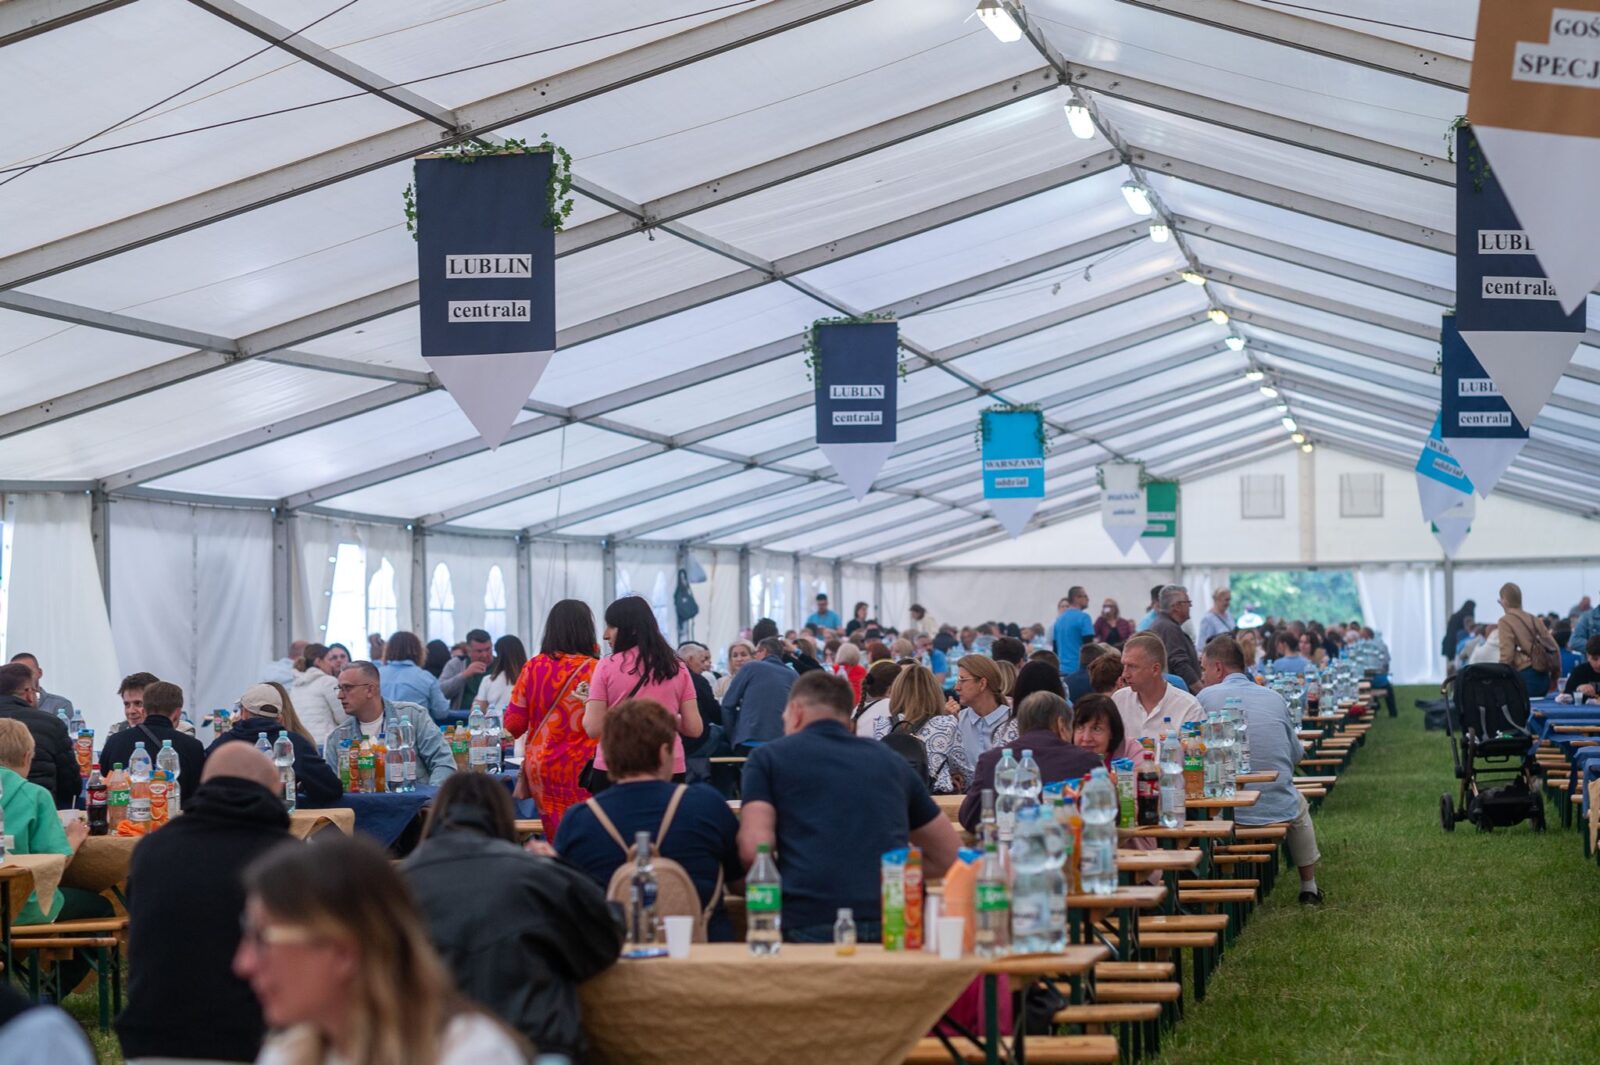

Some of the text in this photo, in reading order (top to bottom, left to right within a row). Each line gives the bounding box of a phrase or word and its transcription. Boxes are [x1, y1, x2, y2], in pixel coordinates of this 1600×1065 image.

[1519, 53, 1600, 79] SPECJ
[1481, 233, 1535, 250] LUBL
[449, 257, 529, 275] LUBLIN
[1485, 280, 1557, 296] centrala
[453, 302, 527, 318] centrala
[833, 387, 882, 396] LUBLIN
[1460, 382, 1497, 392] LUBL
[834, 412, 880, 422] centrala
[1460, 414, 1509, 424] centrala
[986, 459, 1042, 468] WARSZAWA
